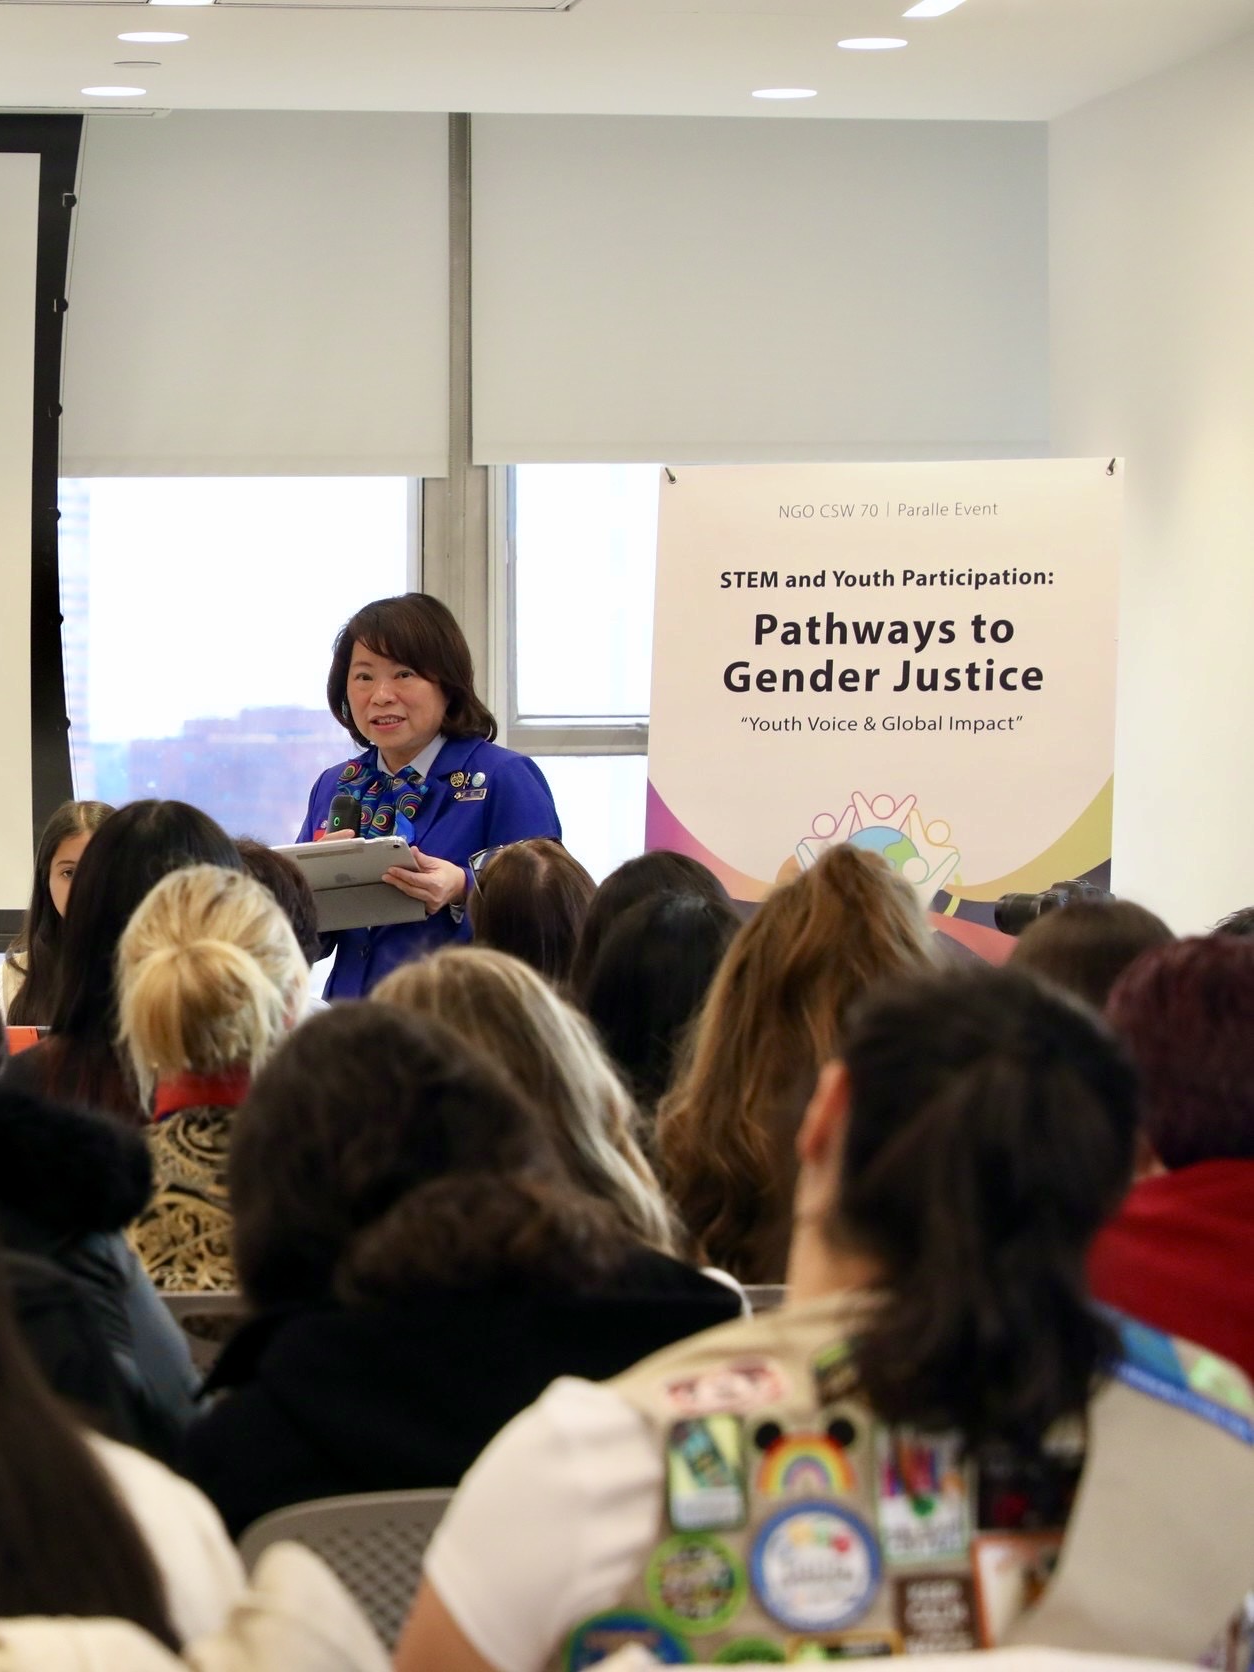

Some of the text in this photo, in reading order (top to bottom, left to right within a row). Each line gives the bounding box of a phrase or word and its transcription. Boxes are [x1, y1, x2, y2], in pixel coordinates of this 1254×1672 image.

[779, 502, 998, 519] NGO CSW 70 Paralle Event
[720, 567, 1055, 590] STEM and Youth Participation:
[754, 611, 1015, 654] Pathways to
[723, 658, 1044, 693] Gender Justice
[807, 716, 858, 732] Voice
[863, 717, 877, 732] &
[881, 715, 943, 732] Global
